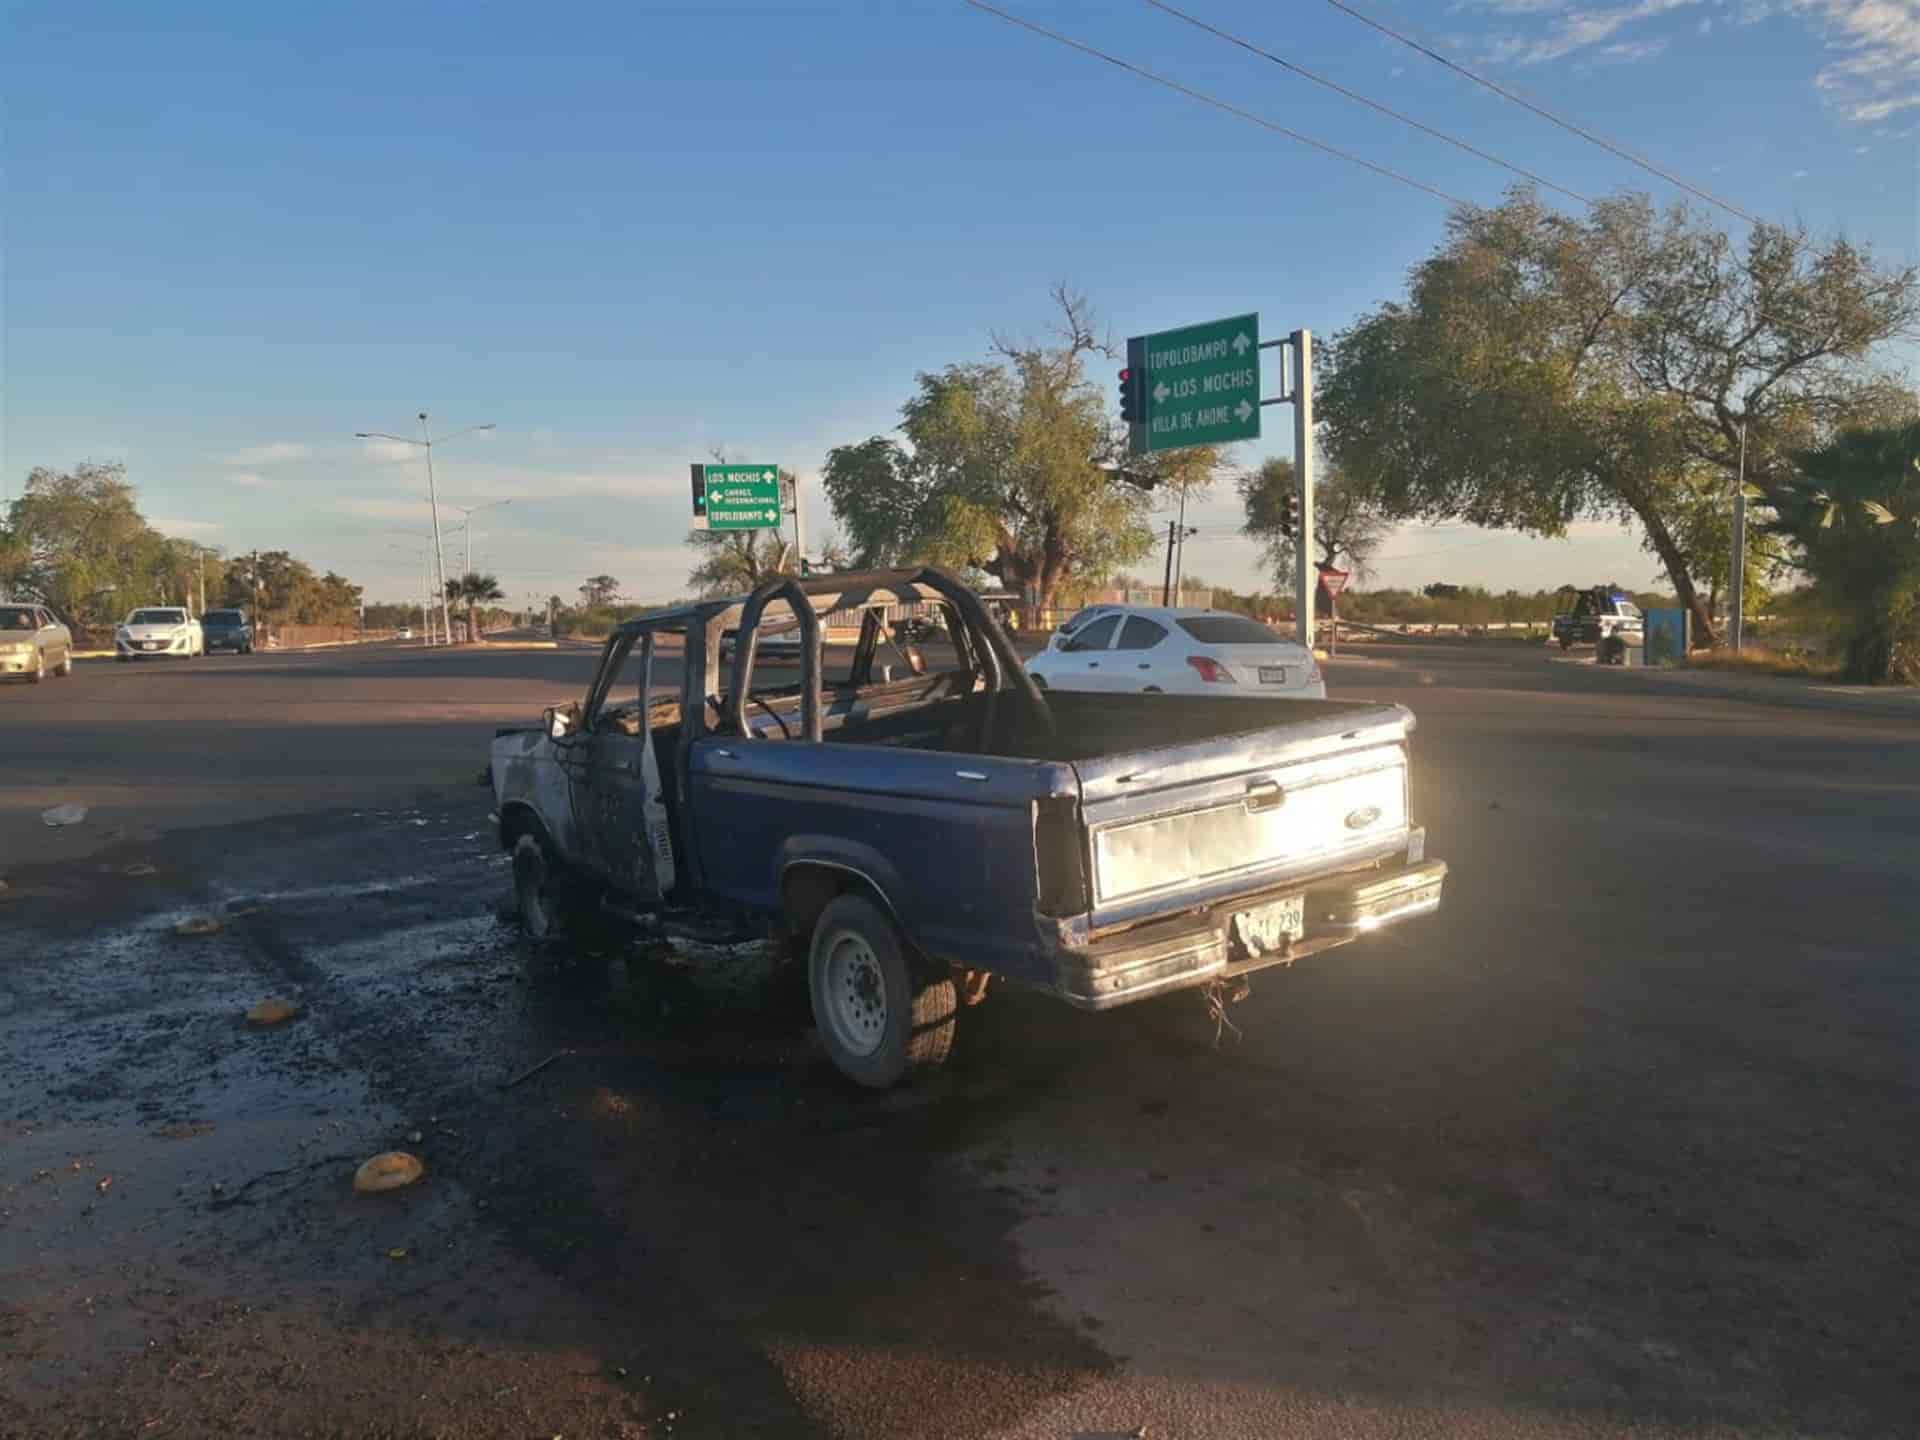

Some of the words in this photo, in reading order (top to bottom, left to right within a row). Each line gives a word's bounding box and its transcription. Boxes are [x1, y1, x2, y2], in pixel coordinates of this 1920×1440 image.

[1150, 338, 1227, 369] TOPOLOBAMPO
[1173, 378, 1197, 398] LOS
[1203, 368, 1254, 393] MOCHIS
[1152, 414, 1178, 433] VILLA
[1181, 410, 1193, 429] DE
[1196, 405, 1231, 426] AHOME
[708, 473, 724, 483] LOS
[728, 472, 760, 483] MOCHIS
[711, 511, 763, 521] TOPOLOBAMPO
